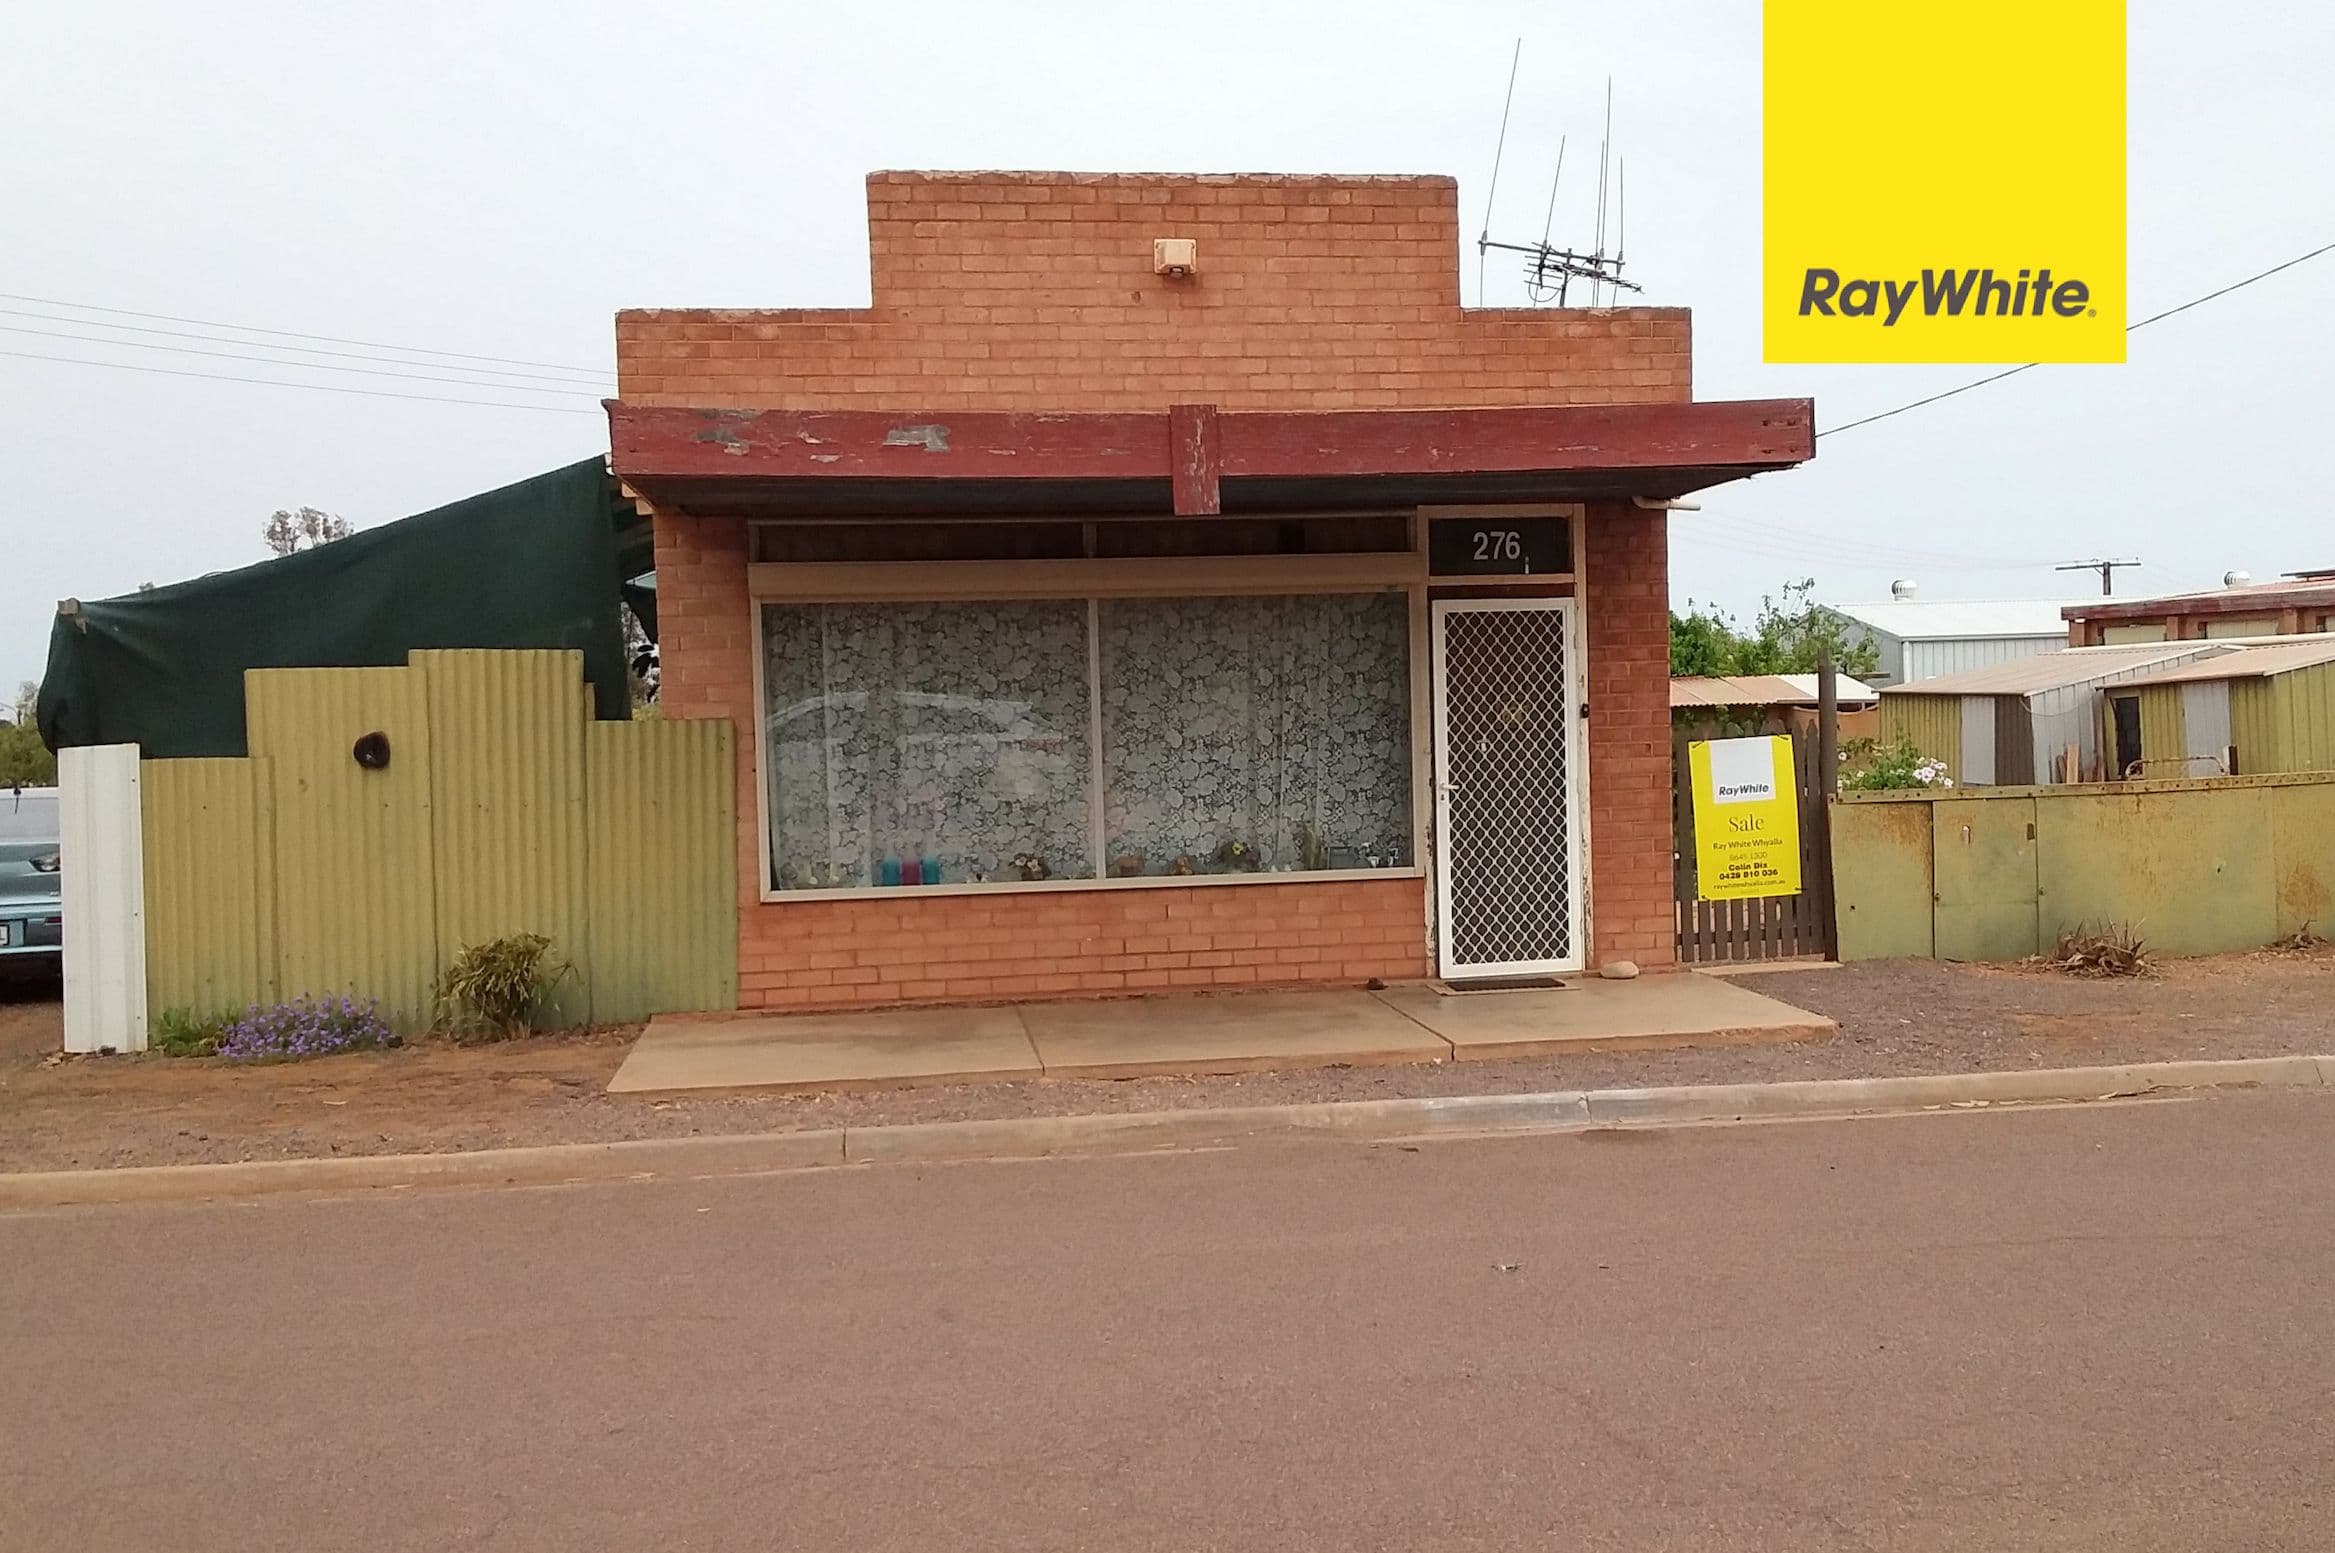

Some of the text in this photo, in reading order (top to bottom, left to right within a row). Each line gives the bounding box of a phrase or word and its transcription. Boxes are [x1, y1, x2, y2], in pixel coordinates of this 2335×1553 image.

[1473, 531, 1520, 560] 276
[1719, 784, 1769, 796] RayWhite
[1729, 813, 1764, 832] Sale
[1713, 837, 1783, 850] Ray White Whyalla
[1728, 861, 1768, 871] Colin Dix
